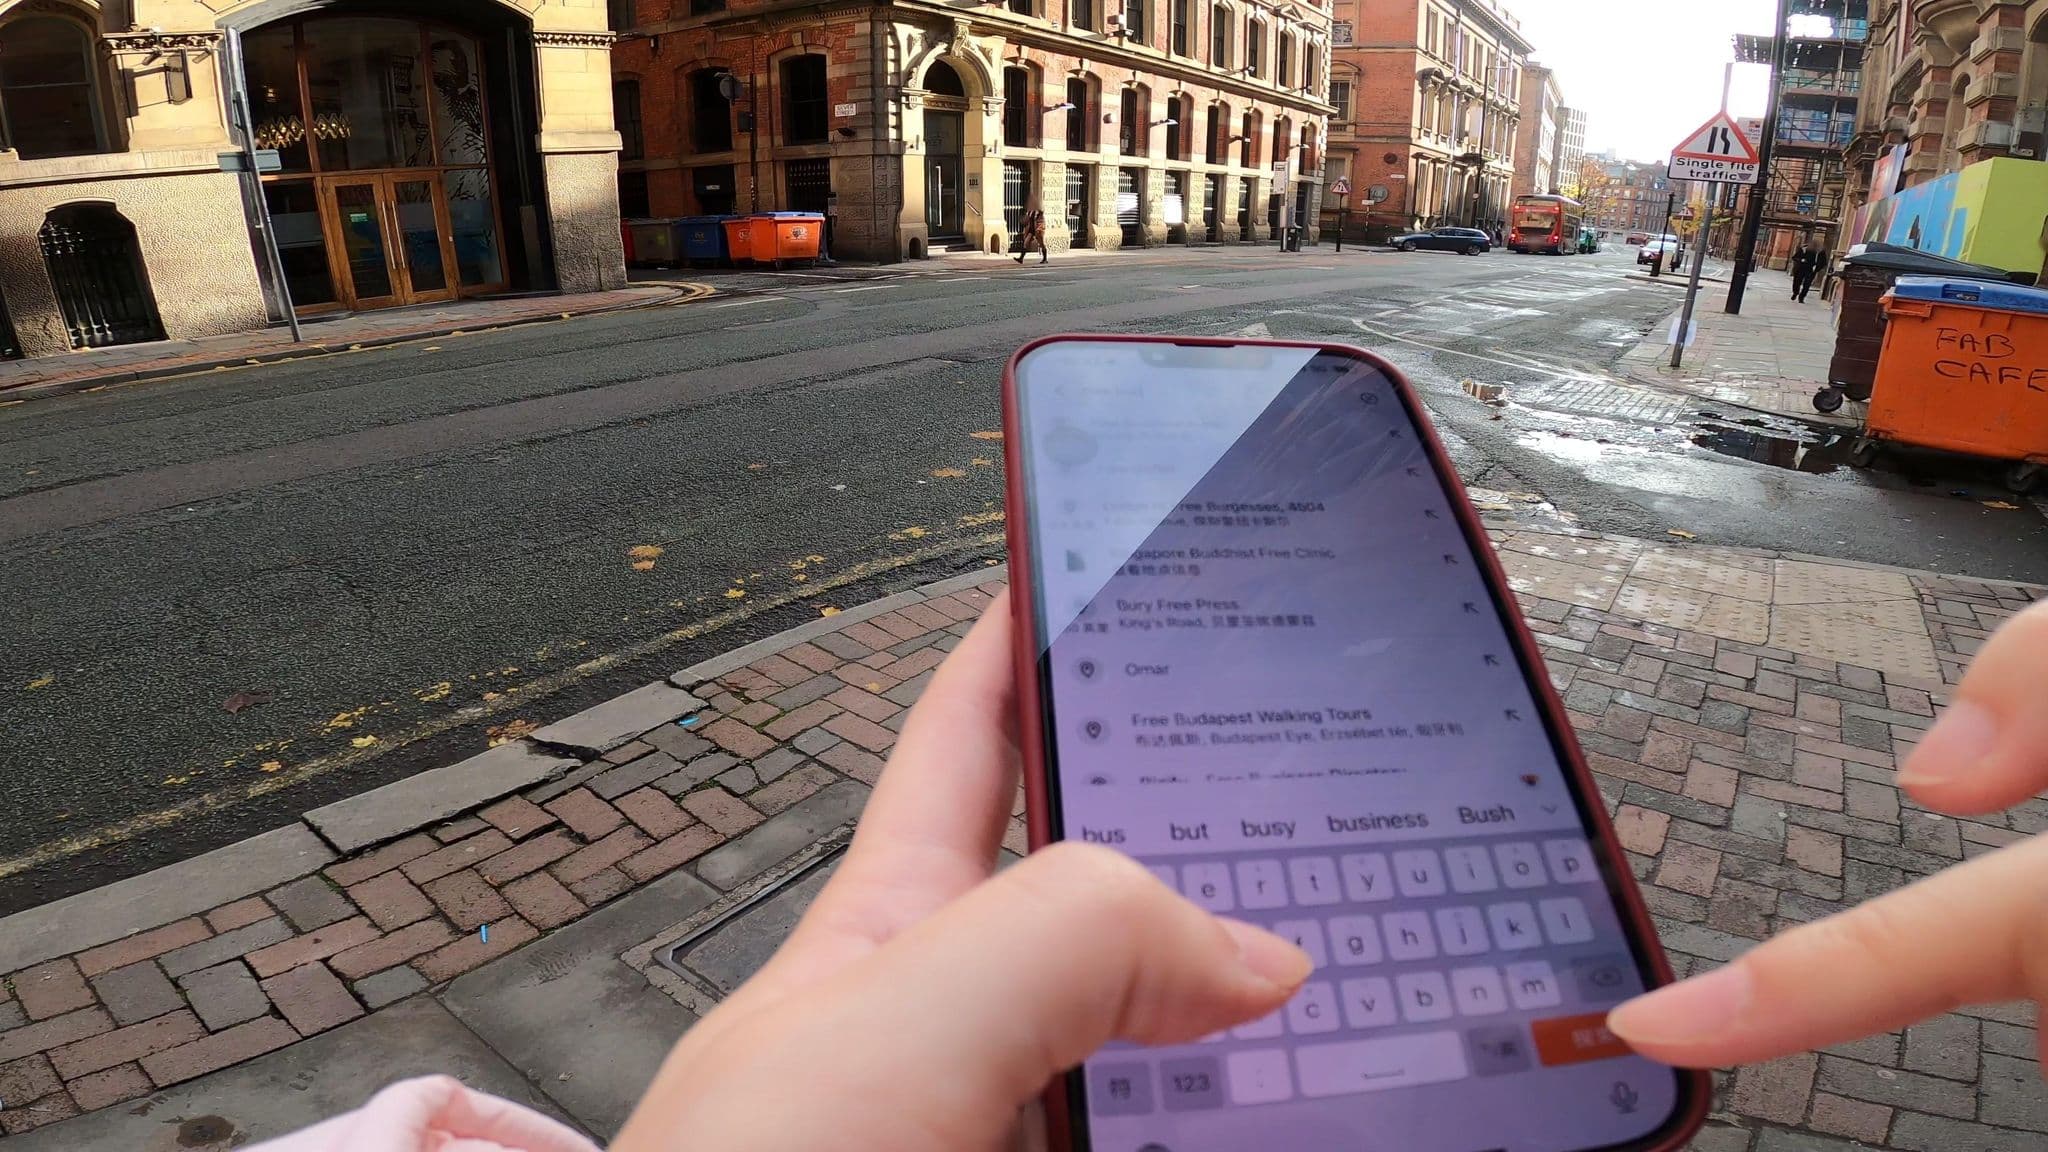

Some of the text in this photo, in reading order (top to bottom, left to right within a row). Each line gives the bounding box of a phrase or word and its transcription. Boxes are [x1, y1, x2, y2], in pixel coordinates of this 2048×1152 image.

[1676, 157, 1755, 171] Single file
[1689, 169, 1738, 180] traffic
[1936, 327, 2015, 358] FAB
[1934, 360, 2048, 392] CAFE
[1190, 548, 1255, 560] Buddhist
[1259, 548, 1291, 559] Free
[1157, 599, 1193, 611] Free
[1196, 599, 1240, 611] Press
[1125, 662, 1169, 677] Omar
[1131, 707, 1372, 727] Free Budapest Walking Tours
[1082, 804, 1516, 845] bus but busy business Bush
[1201, 856, 1580, 899] e r t y u i o p
[1347, 935, 1365, 957] g
[1399, 927, 1418, 946] h
[1506, 918, 1522, 936] k
[1306, 976, 1547, 1019] c v b n m
[1173, 1073, 1212, 1094] 123
